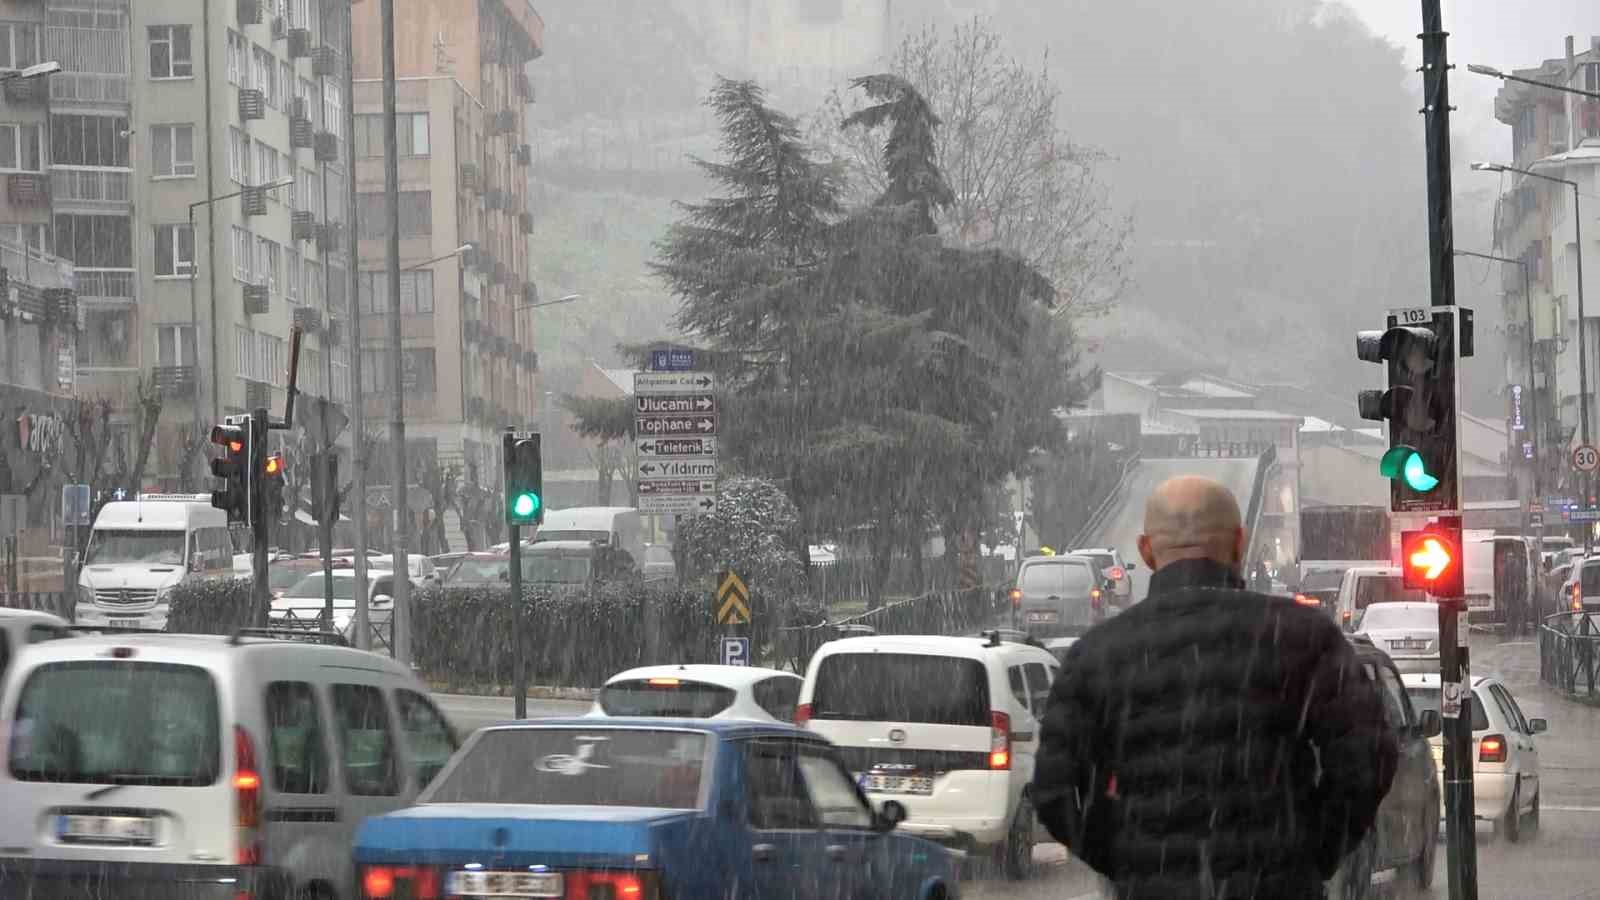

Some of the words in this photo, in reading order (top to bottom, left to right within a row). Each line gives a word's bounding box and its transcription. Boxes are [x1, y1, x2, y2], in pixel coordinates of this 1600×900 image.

[1403, 310, 1425, 323] 103
[640, 418, 692, 434] Tophane
[1577, 452, 1595, 465] 30
[660, 463, 714, 475] Yıldırım
